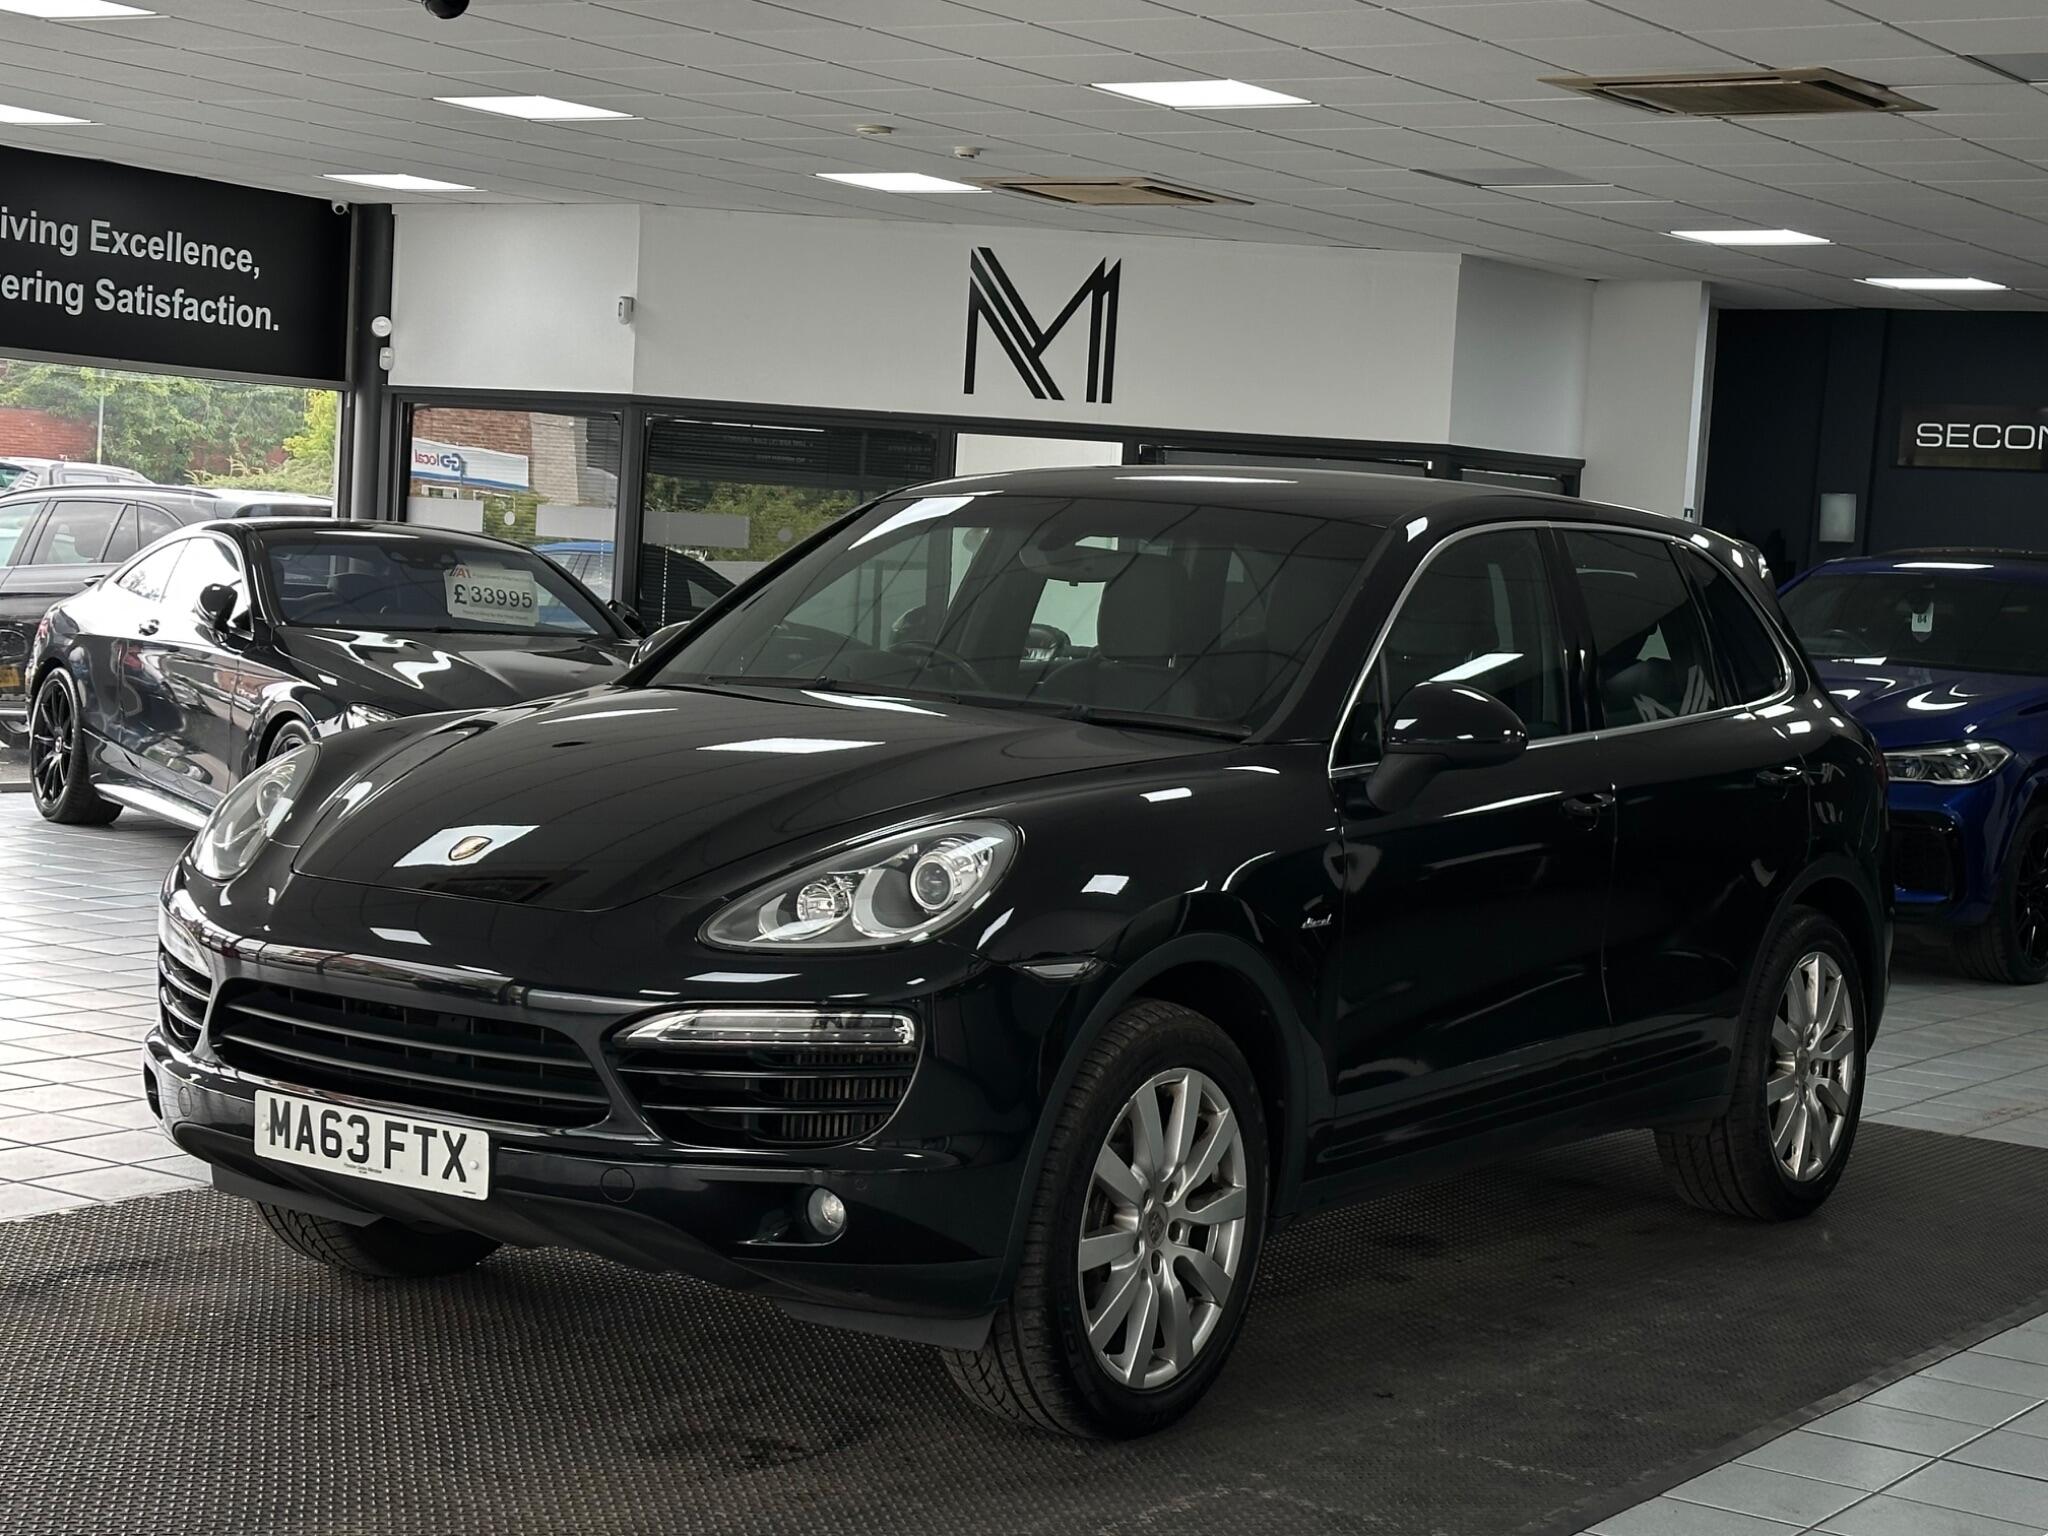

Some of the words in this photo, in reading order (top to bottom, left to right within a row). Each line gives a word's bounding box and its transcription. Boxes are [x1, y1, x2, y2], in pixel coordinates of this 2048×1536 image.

[90, 219, 260, 279] Excellence,
[0, 270, 83, 315] ering
[94, 278, 279, 330] Satisfaction.
[454, 584, 532, 608] £33995
[270, 1098, 369, 1164] MA63
[384, 1120, 467, 1182] FTX
